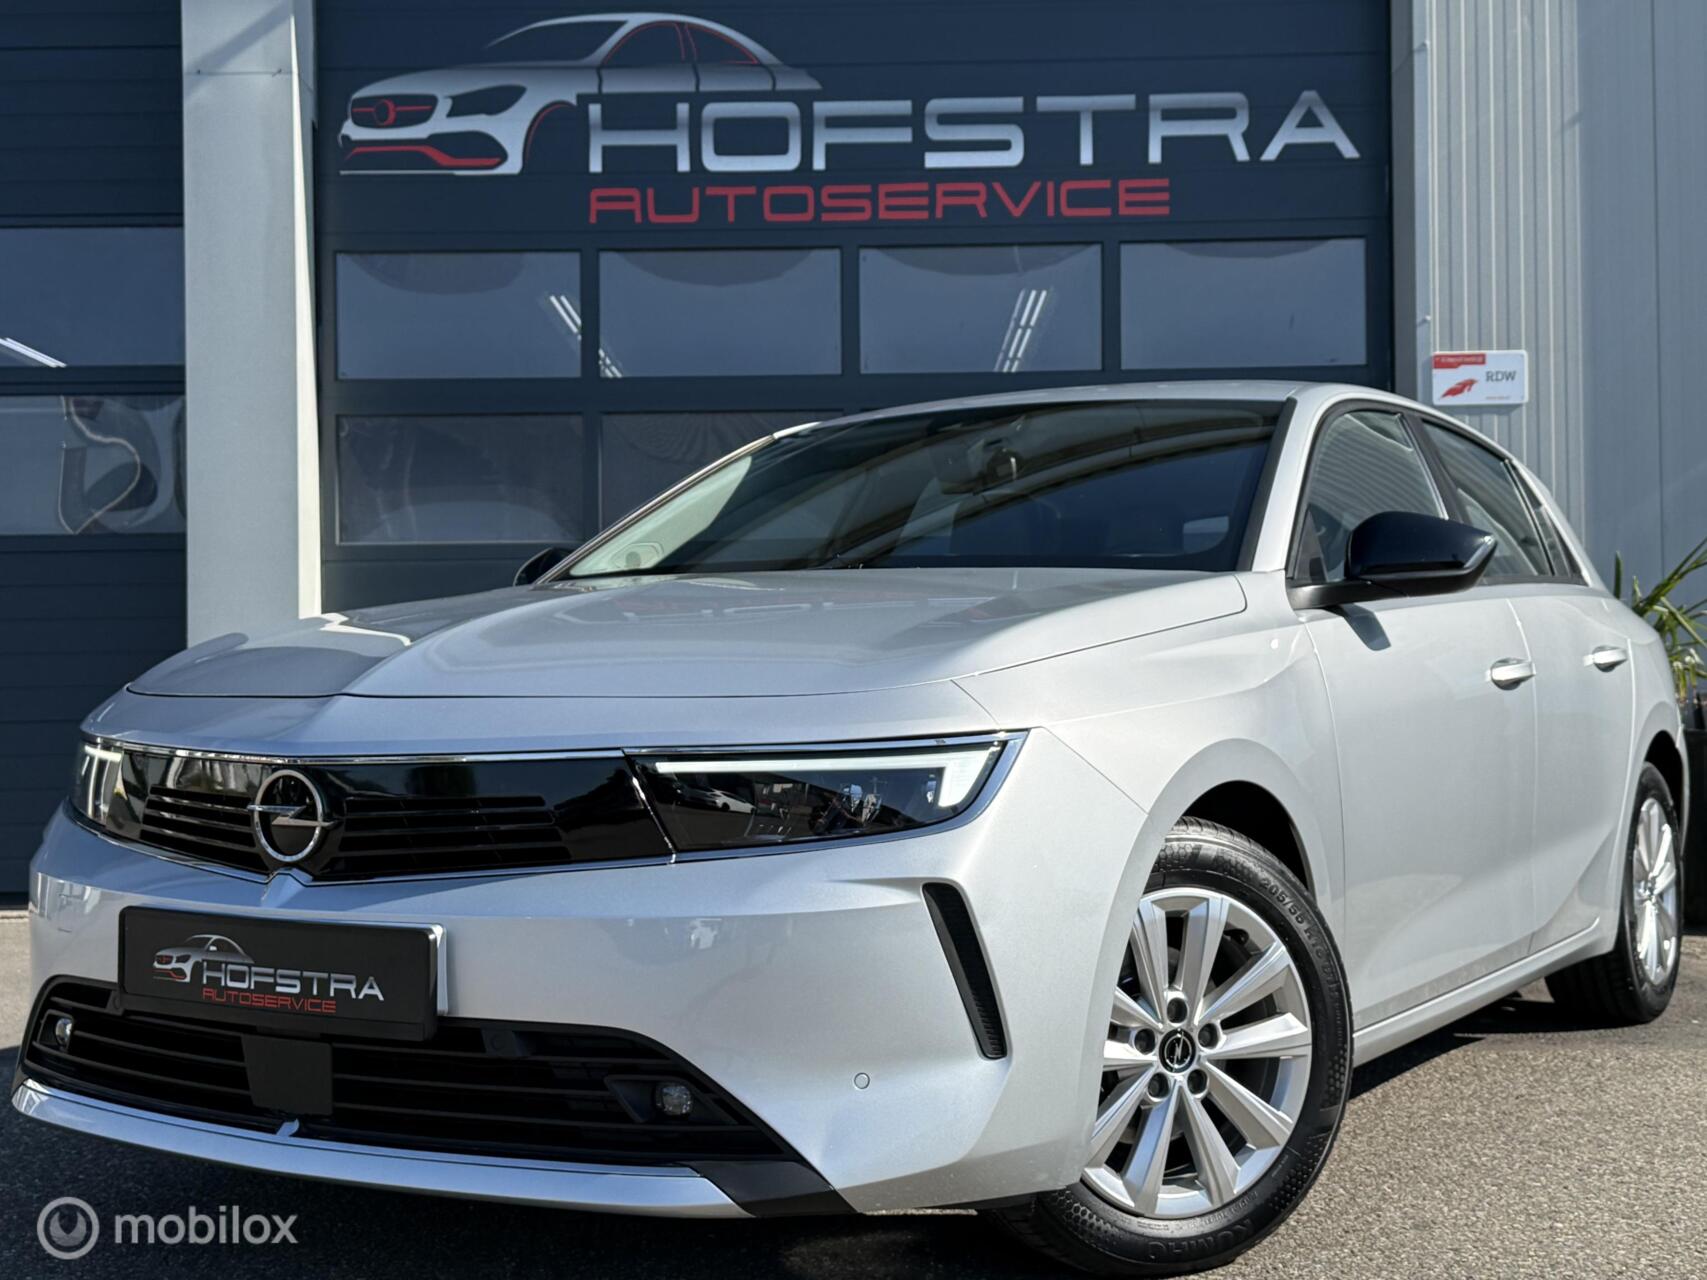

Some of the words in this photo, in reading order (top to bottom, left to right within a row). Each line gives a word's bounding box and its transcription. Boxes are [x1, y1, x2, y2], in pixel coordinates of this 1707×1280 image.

[588, 91, 1361, 173] HOFSTRA
[588, 179, 1171, 224] AUTOSERVICE
[1485, 370, 1517, 382] RDW
[1261, 878, 1305, 925] 205/55
[202, 962, 385, 1001] HOFSTRA
[202, 988, 337, 1013] AUTOSERVICE
